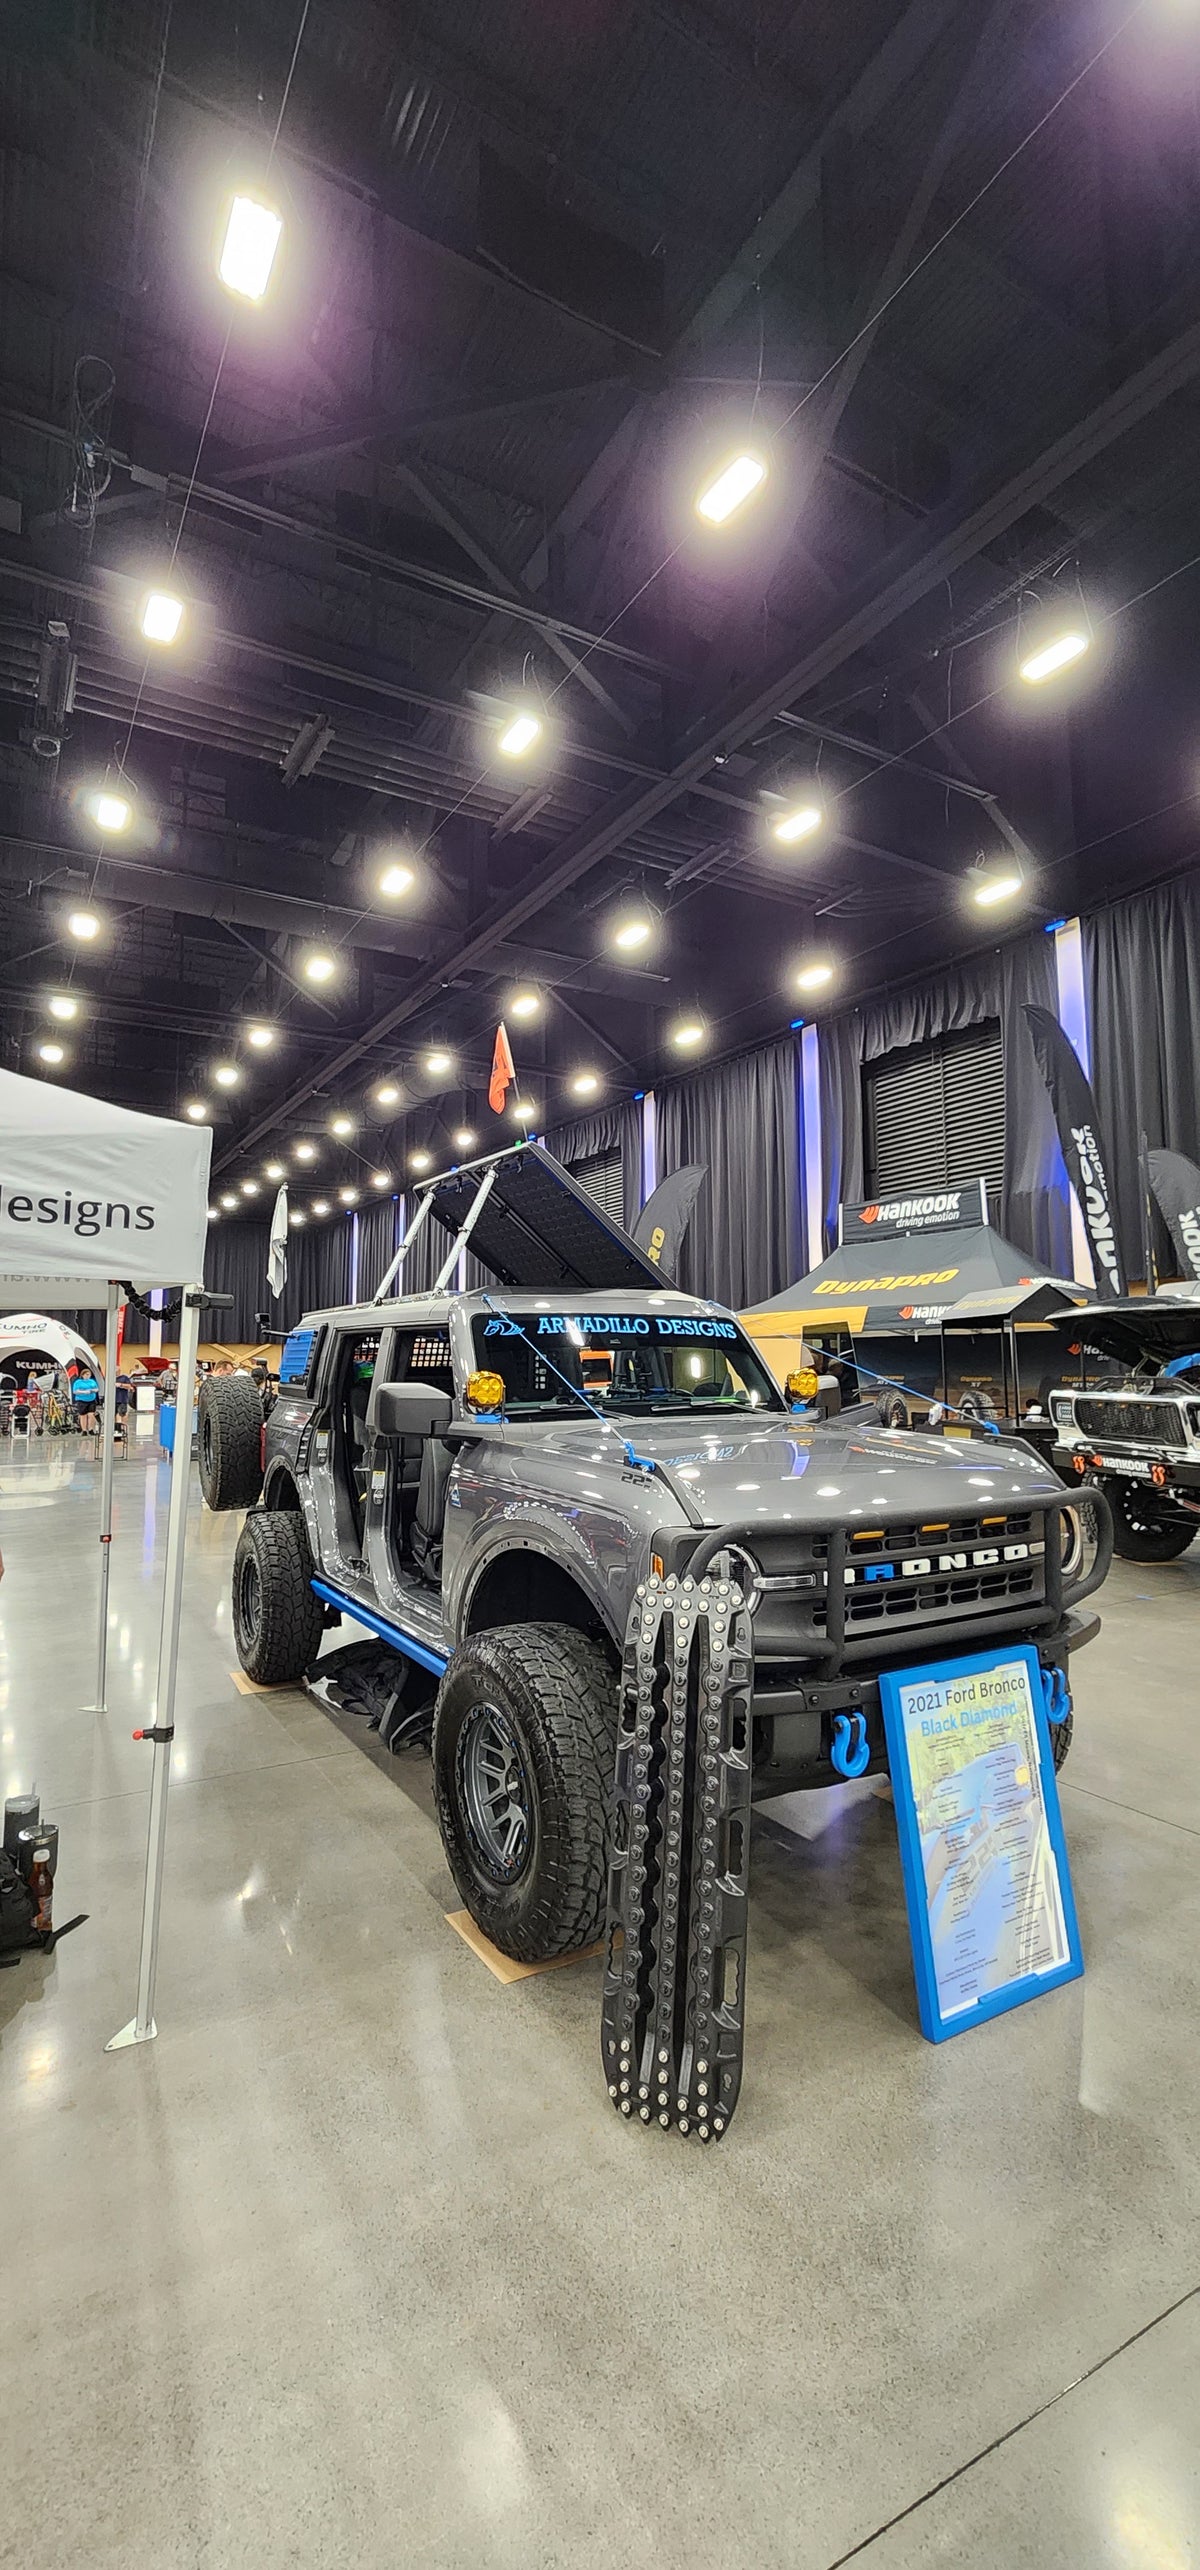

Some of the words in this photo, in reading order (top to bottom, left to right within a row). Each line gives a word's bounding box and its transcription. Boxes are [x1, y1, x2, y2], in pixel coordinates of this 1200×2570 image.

[0, 1185, 156, 1237] esigns
[896, 1216, 924, 1228] driving
[924, 1210, 960, 1224] emotion
[537, 1317, 649, 1335] ARMADILLO
[656, 1318, 737, 1339] DESIGNS
[16, 1360, 62, 1370] KUMH
[908, 1692, 942, 1714] 2021
[945, 1684, 976, 1706] Ford
[980, 1677, 1026, 1699] Bronco
[921, 1714, 958, 1737] Black
[960, 1702, 1018, 1727] Diamond
